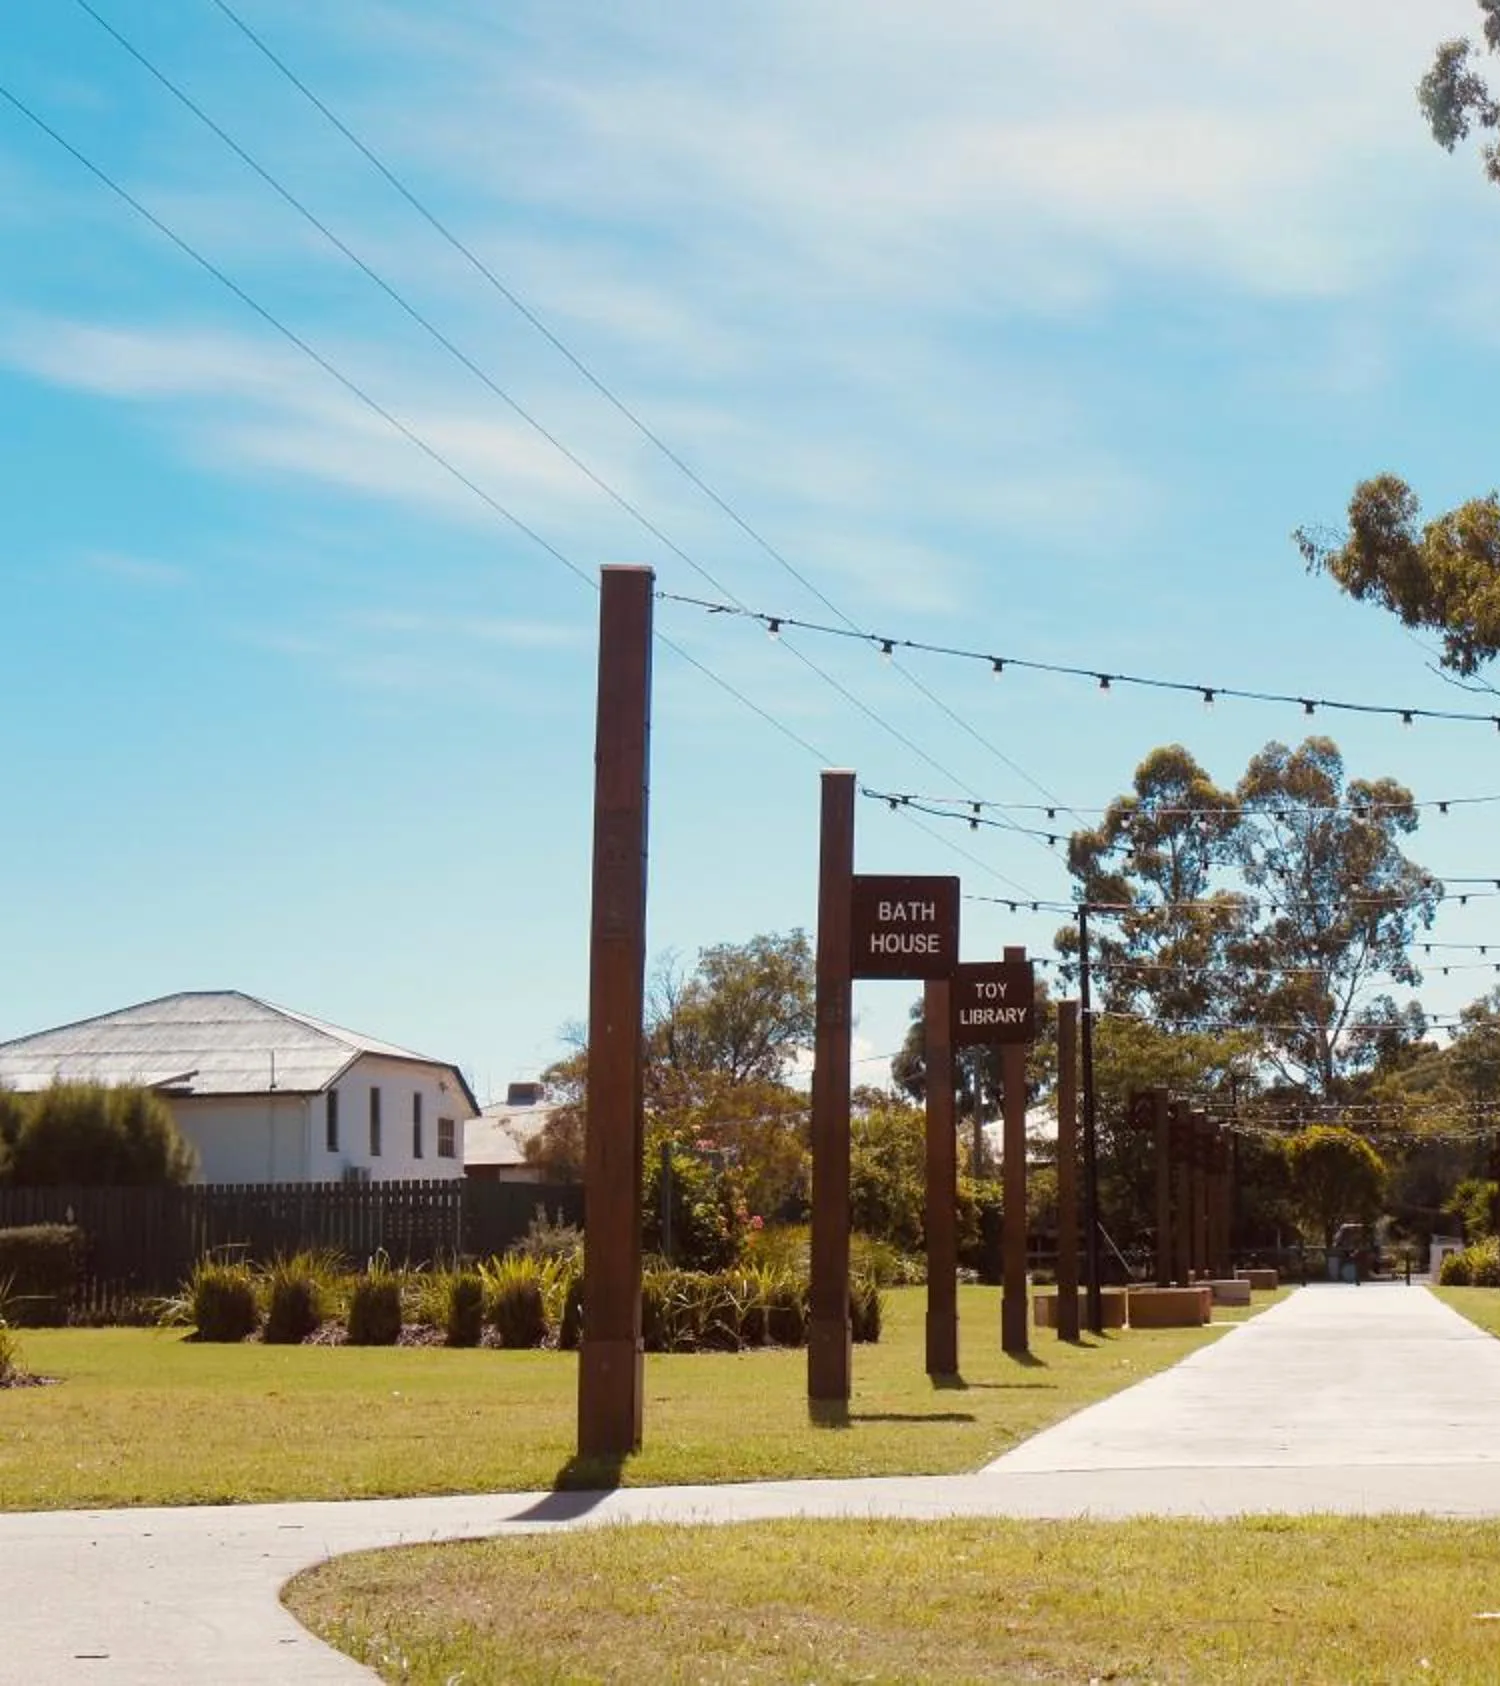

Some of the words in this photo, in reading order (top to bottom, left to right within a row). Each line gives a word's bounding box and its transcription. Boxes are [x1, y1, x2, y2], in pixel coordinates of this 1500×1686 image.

[879, 901, 935, 921] BATH
[871, 933, 941, 953] HOUSE
[975, 983, 1007, 999] TOY
[960, 1007, 1027, 1025] LIBRARY
